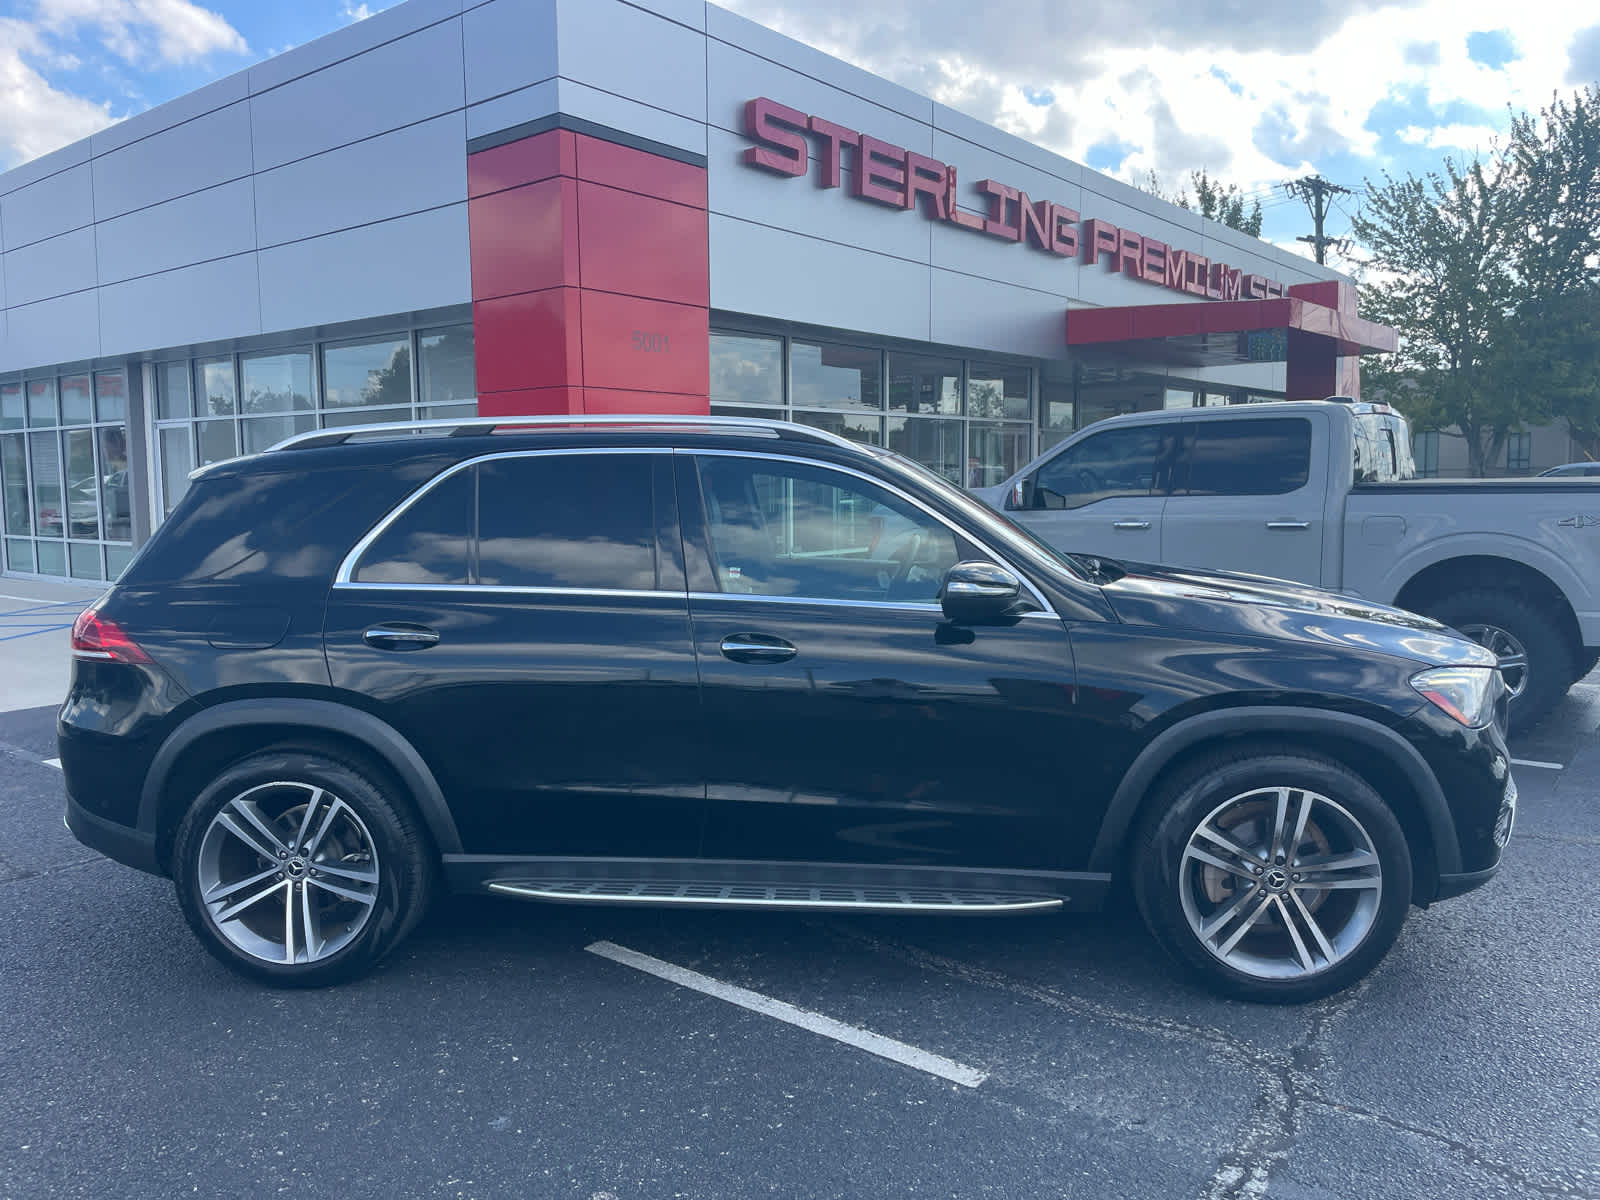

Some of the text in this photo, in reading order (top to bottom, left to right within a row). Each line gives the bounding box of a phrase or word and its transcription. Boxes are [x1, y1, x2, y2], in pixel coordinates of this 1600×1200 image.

[744, 96, 1080, 257] STERLING
[1084, 218, 1242, 301] PREMIUM
[632, 330, 670, 352] 5001
